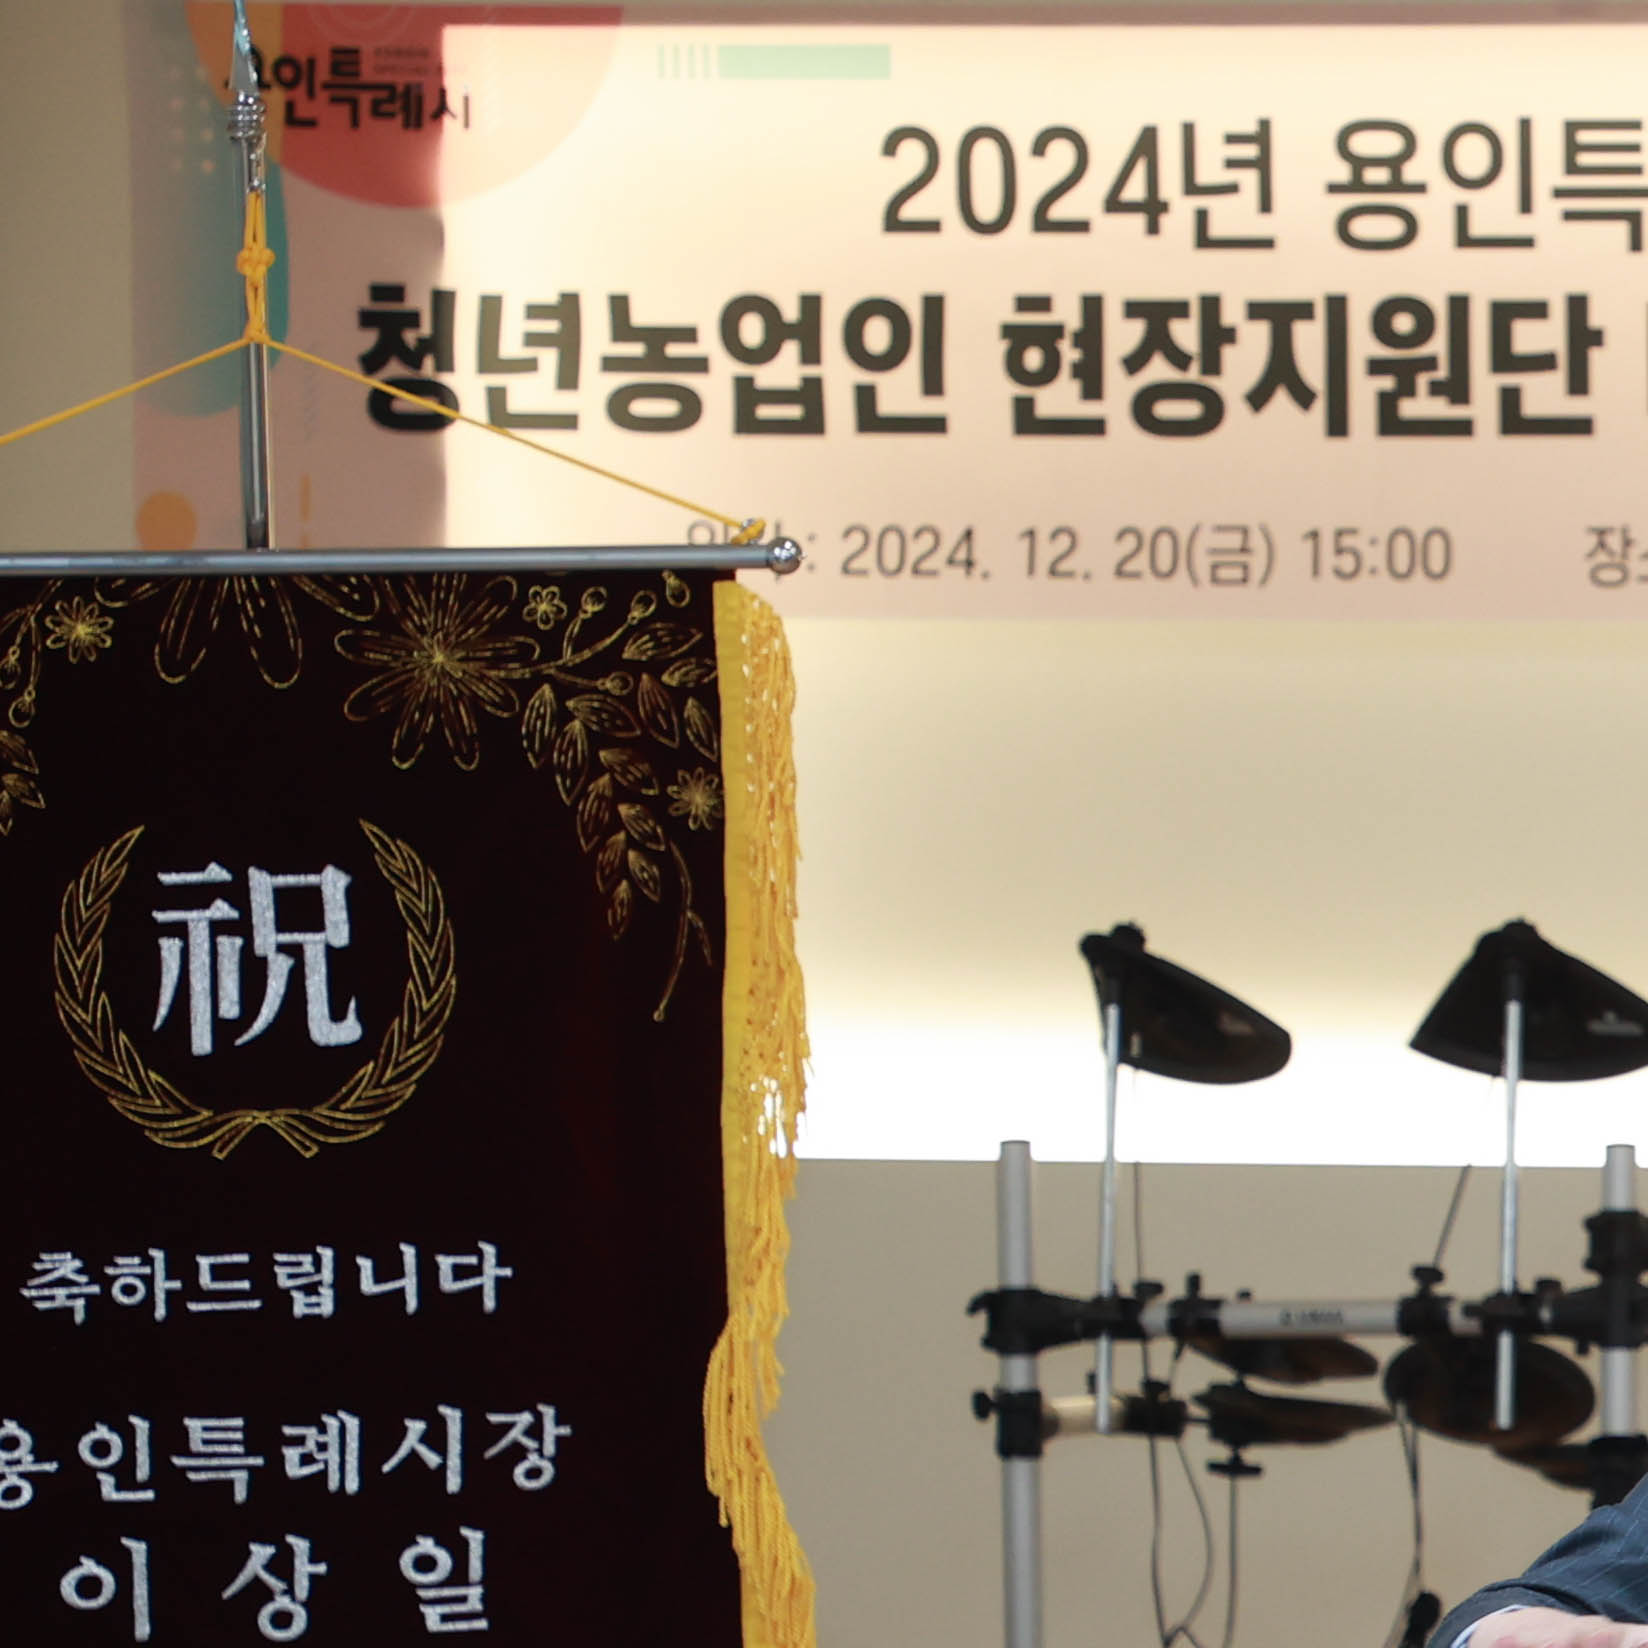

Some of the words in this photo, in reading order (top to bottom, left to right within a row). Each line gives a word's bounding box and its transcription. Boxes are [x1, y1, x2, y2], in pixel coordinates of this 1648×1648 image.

[881, 118, 1275, 249] 2024년
[357, 282, 948, 434] 청년농업인
[1001, 295, 1604, 437] 현장지원단
[840, 524, 991, 581] 2024.
[1018, 525, 1092, 581] 12.
[1114, 523, 1275, 588] 20(금)
[1302, 525, 1453, 581] 15:00
[151, 862, 363, 1056] 祝
[18, 1240, 513, 1324] 축하드립니다
[0, 1404, 573, 1510] 용인특례시장
